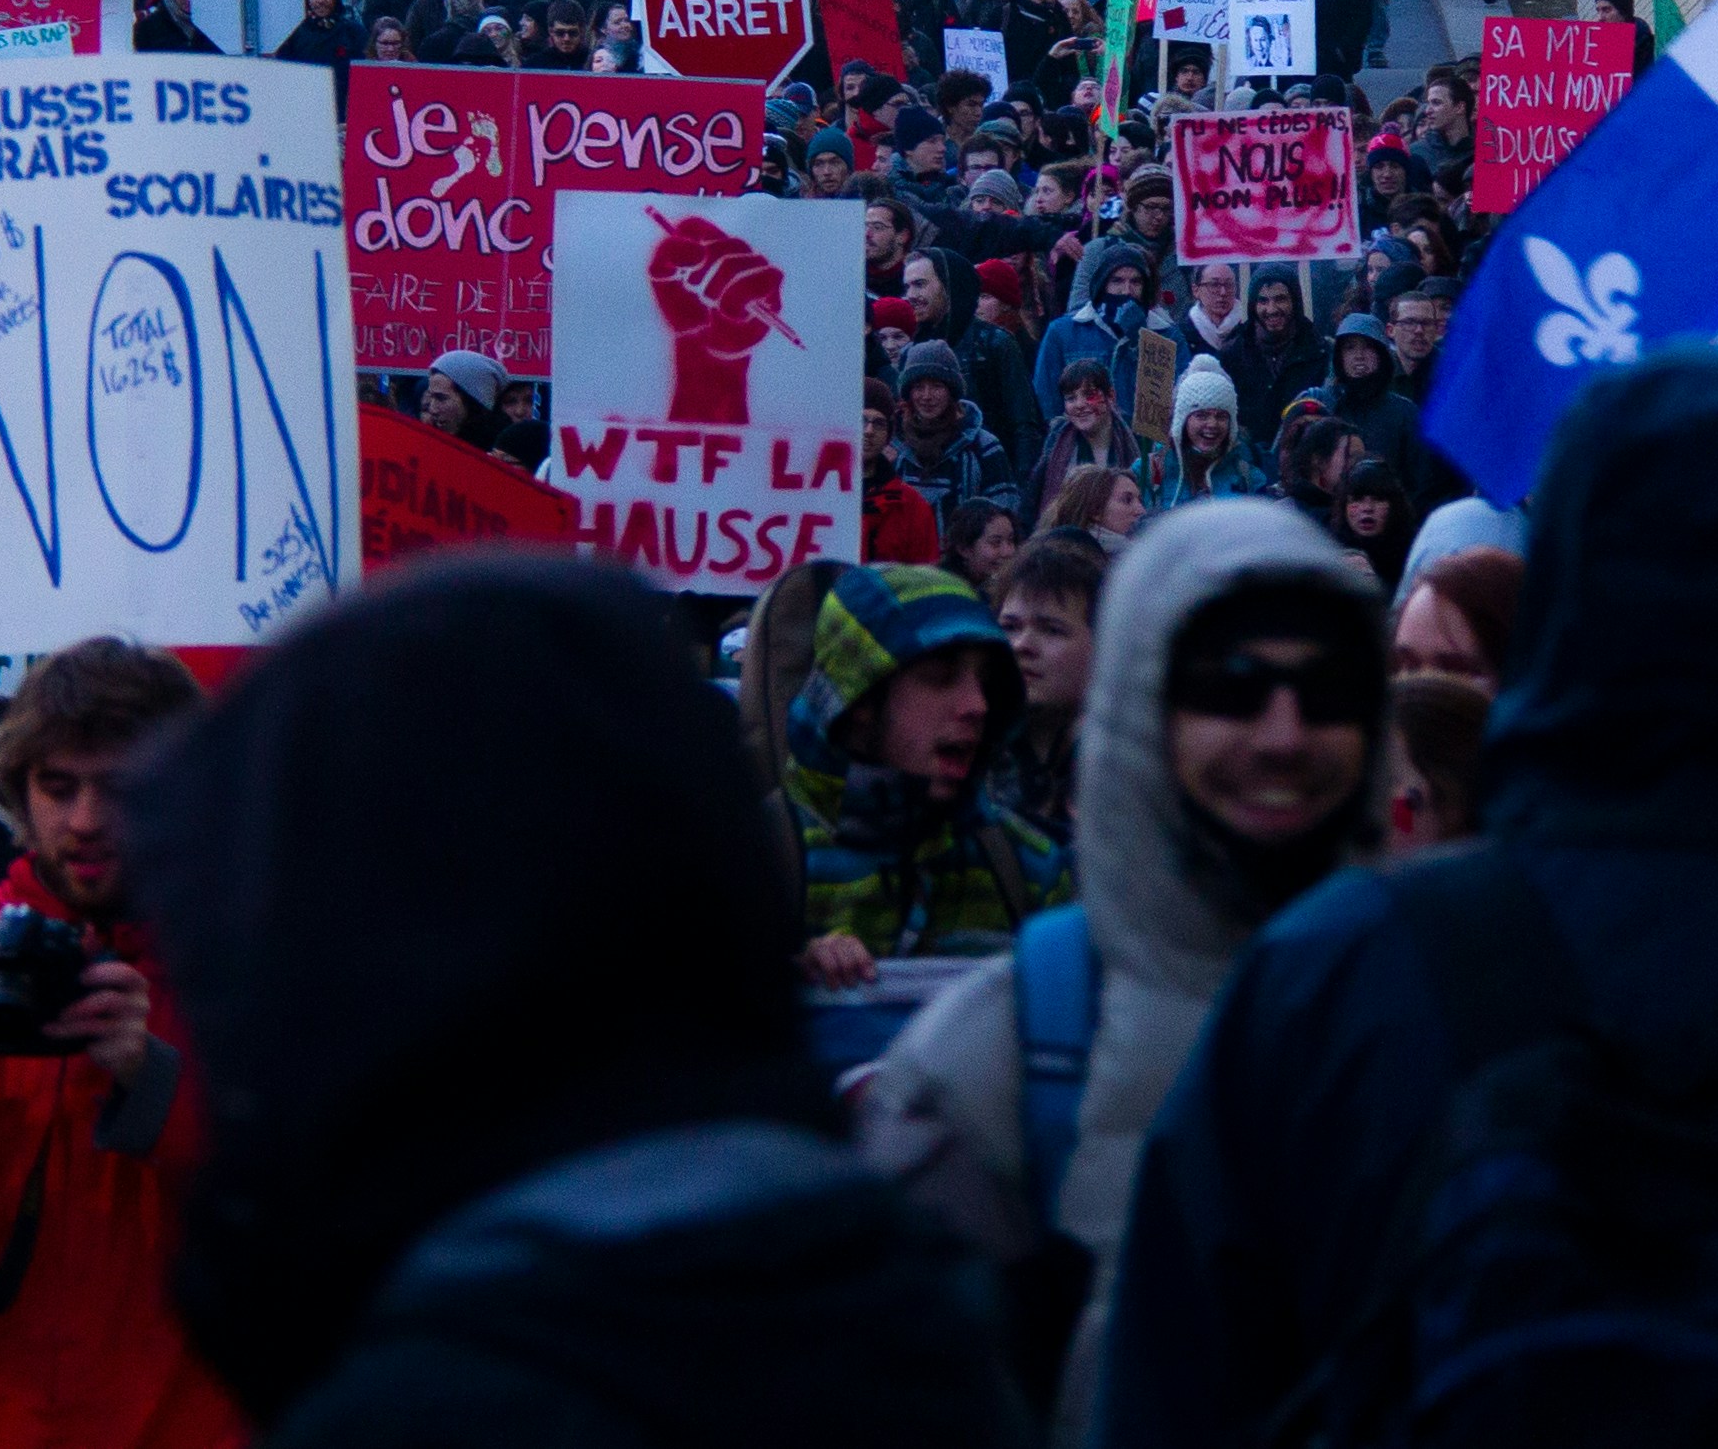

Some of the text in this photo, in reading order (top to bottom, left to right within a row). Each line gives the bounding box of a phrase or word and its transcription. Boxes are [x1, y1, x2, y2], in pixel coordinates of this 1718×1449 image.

[1491, 24, 1526, 59] SA
[154, 79, 252, 126] DES
[1485, 71, 1633, 114] PRAN MONT
[364, 85, 761, 188] je pense,
[1177, 118, 1206, 137] TU
[1217, 116, 1248, 136] NE
[1218, 140, 1306, 184] NOUS
[354, 177, 534, 255] donc
[1191, 187, 1252, 211] NON
[349, 271, 443, 314] FAIRE
[456, 279, 498, 315] DE
[100, 307, 178, 350] TOTAL
[354, 321, 438, 359] UESTION
[559, 424, 855, 494] WTF LA
[575, 499, 836, 584] HAUSSE
